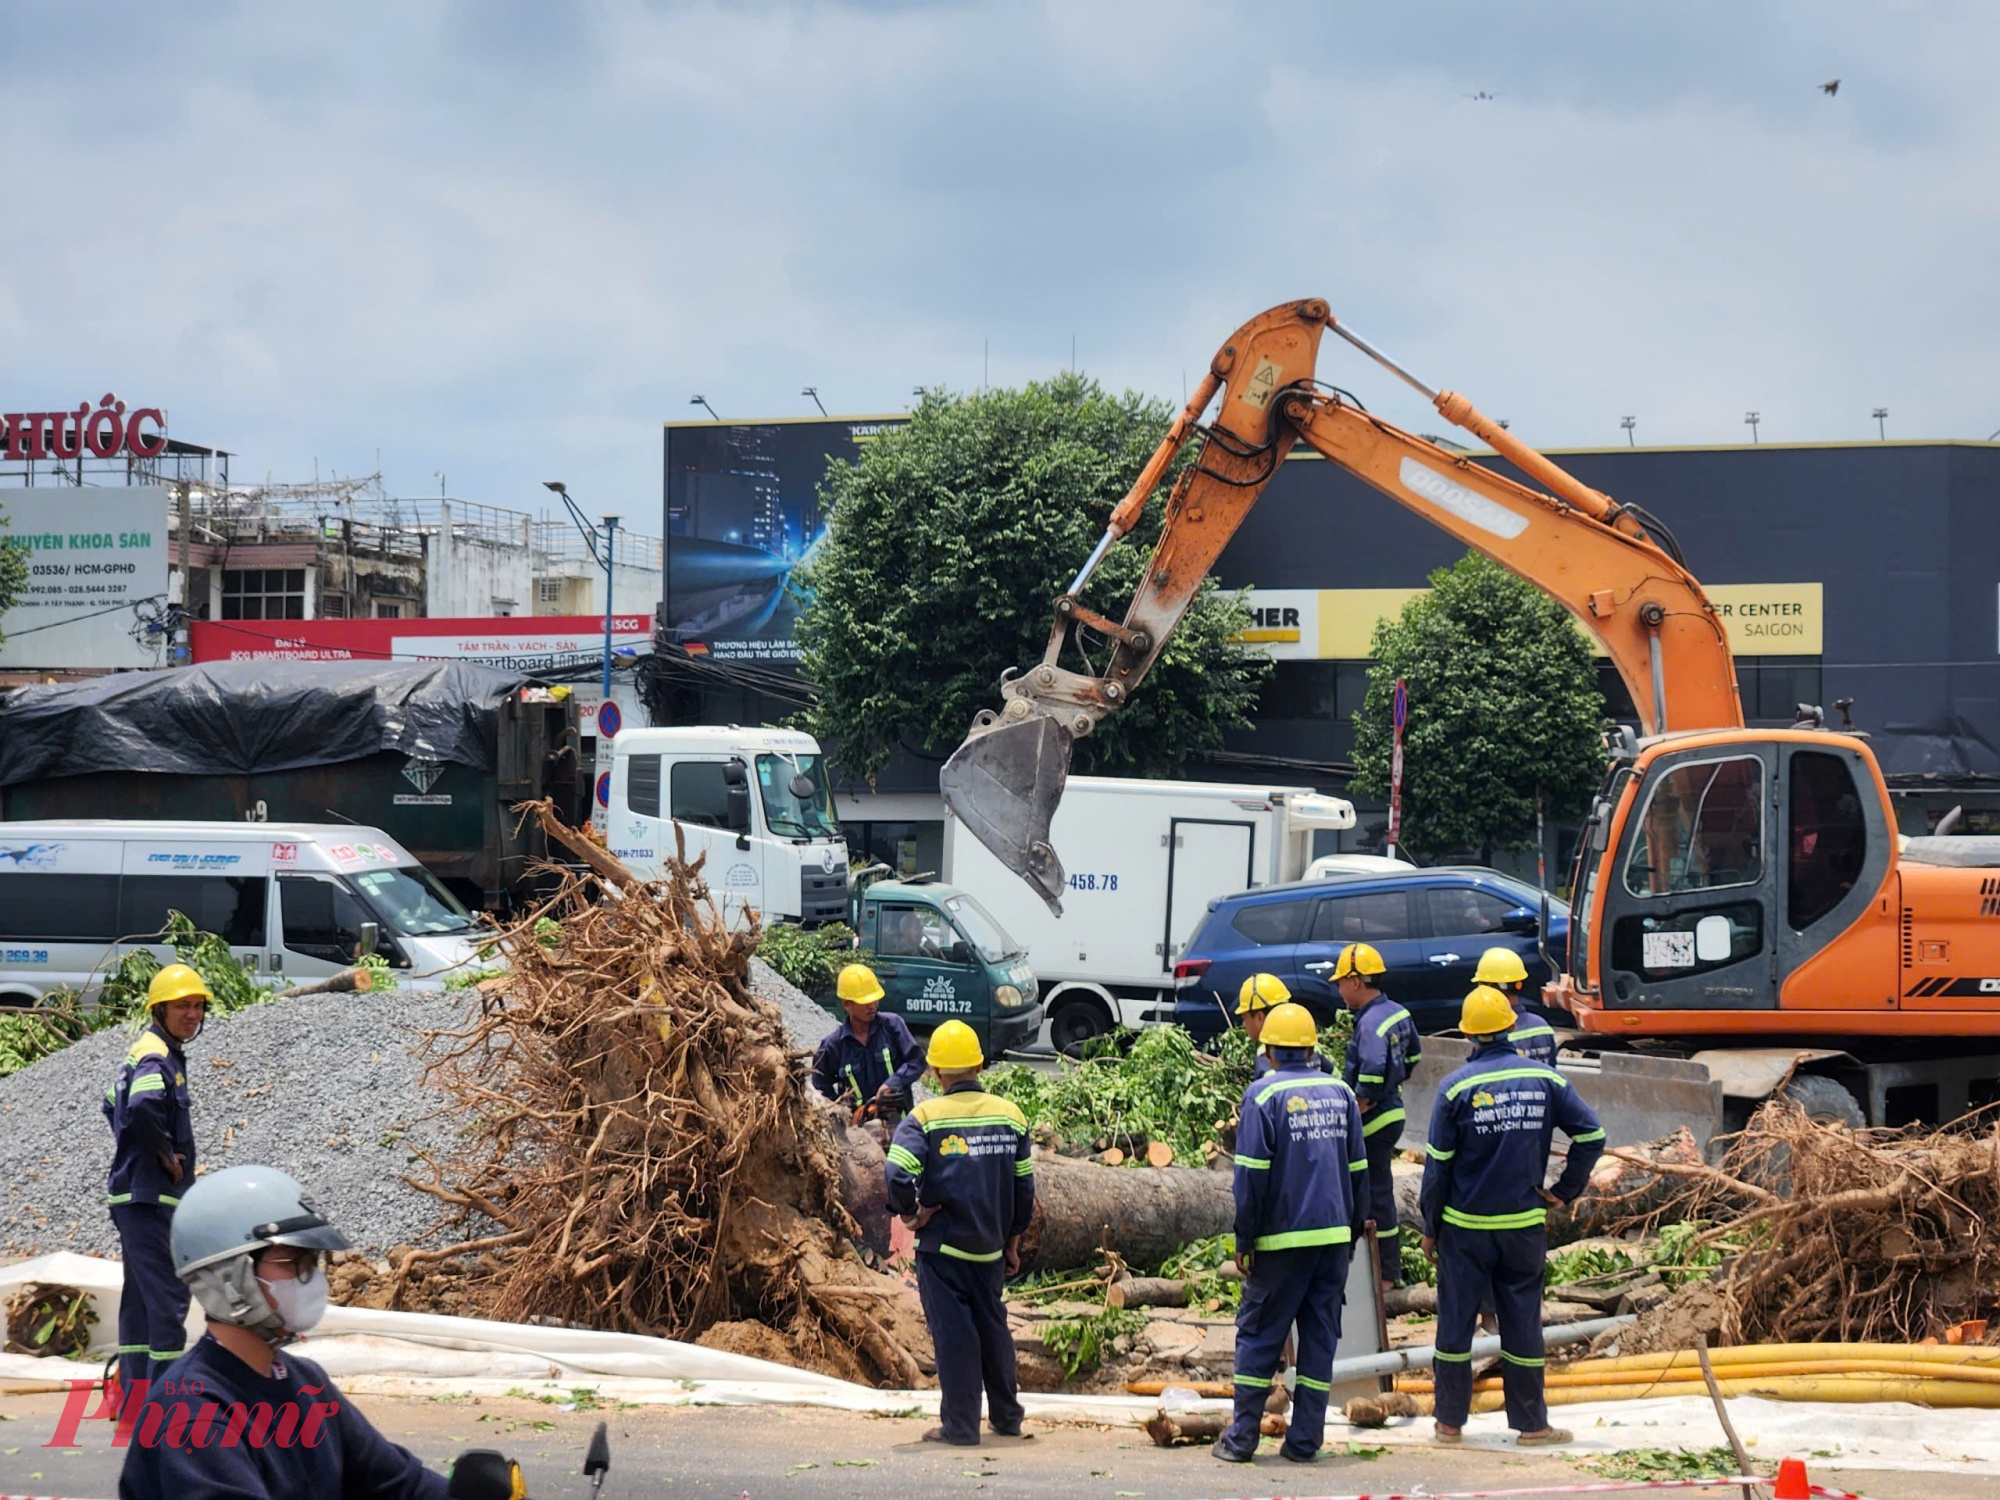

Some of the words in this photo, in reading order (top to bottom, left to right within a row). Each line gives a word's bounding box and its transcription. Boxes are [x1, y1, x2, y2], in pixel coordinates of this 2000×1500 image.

[0, 392, 168, 460] HƯỚC
[10, 532, 63, 550] HUYÊN
[69, 533, 114, 549] KHOA
[1739, 603, 1802, 616] CENTER
[615, 619, 639, 630] SCG
[1745, 623, 1803, 637] SAIGON
[320, 650, 352, 659] ULTRA
[906, 998, 972, 1013] 50TD-013.72
